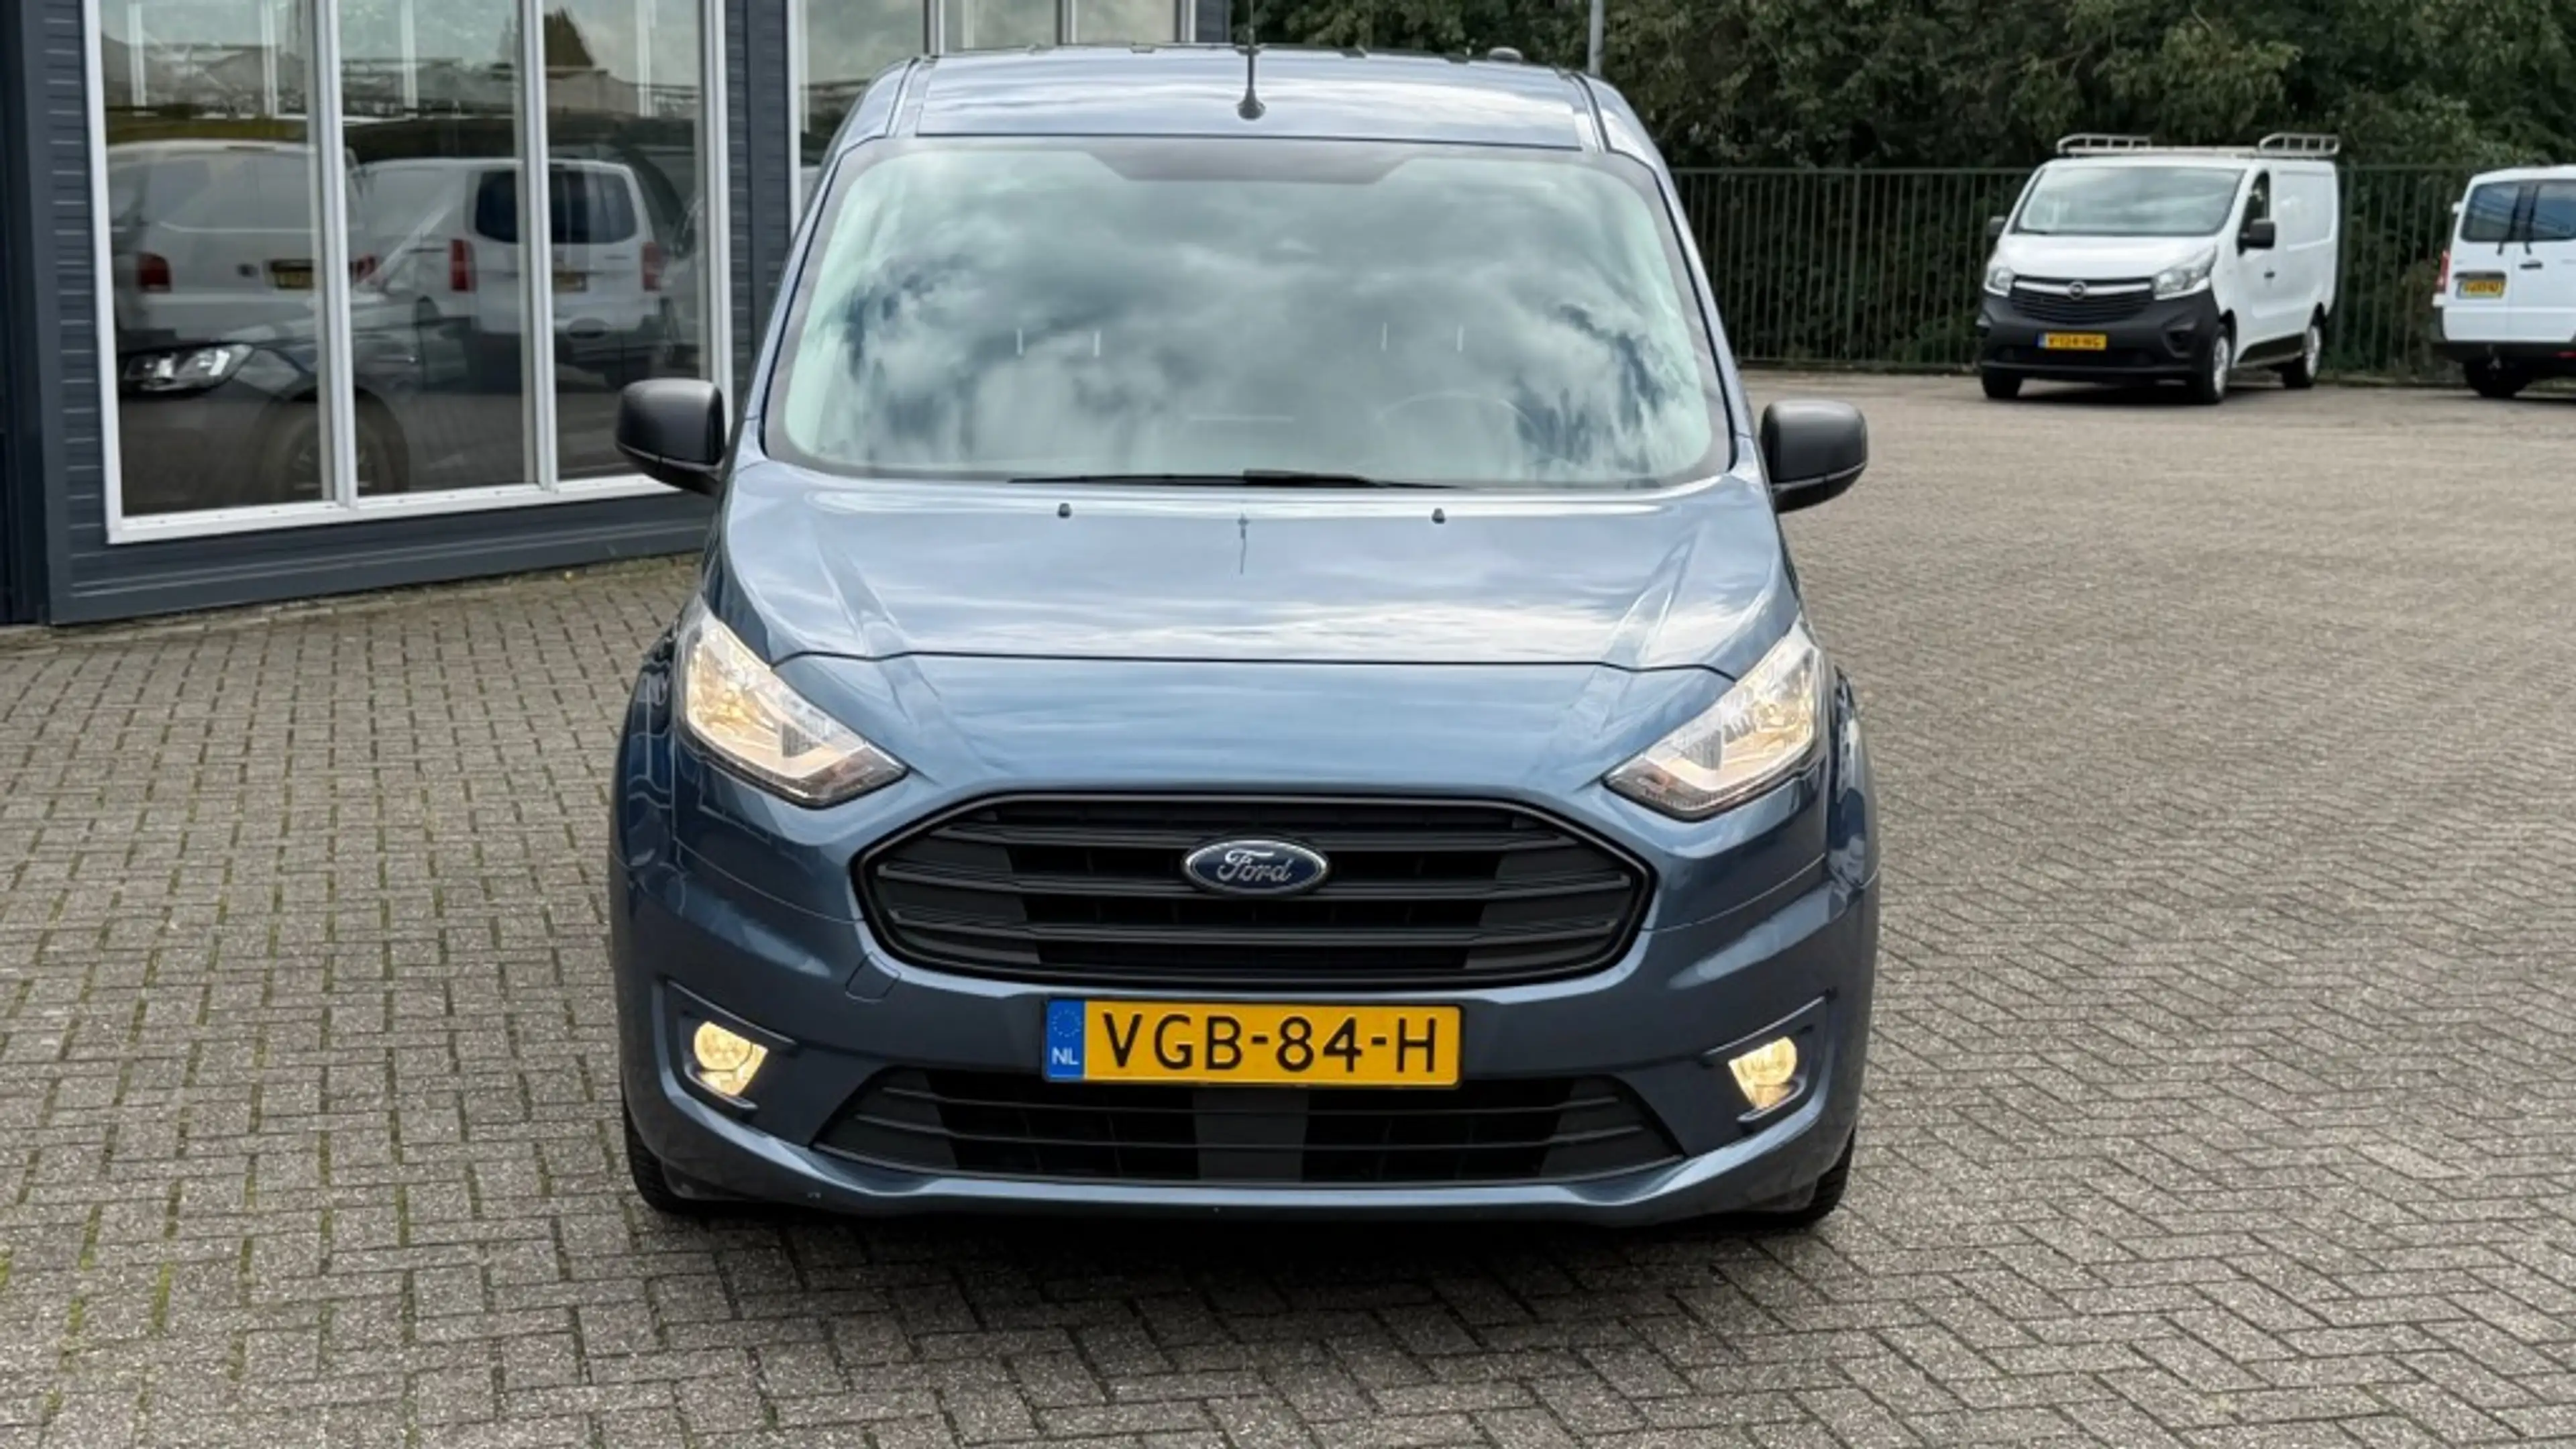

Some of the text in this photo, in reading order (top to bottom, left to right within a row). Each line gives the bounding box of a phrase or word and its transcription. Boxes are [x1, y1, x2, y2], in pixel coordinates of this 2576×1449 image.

[1217, 848, 1293, 882] Ford
[1051, 1046, 1079, 1065] NL
[1102, 1012, 1437, 1073] VGB-84-H
